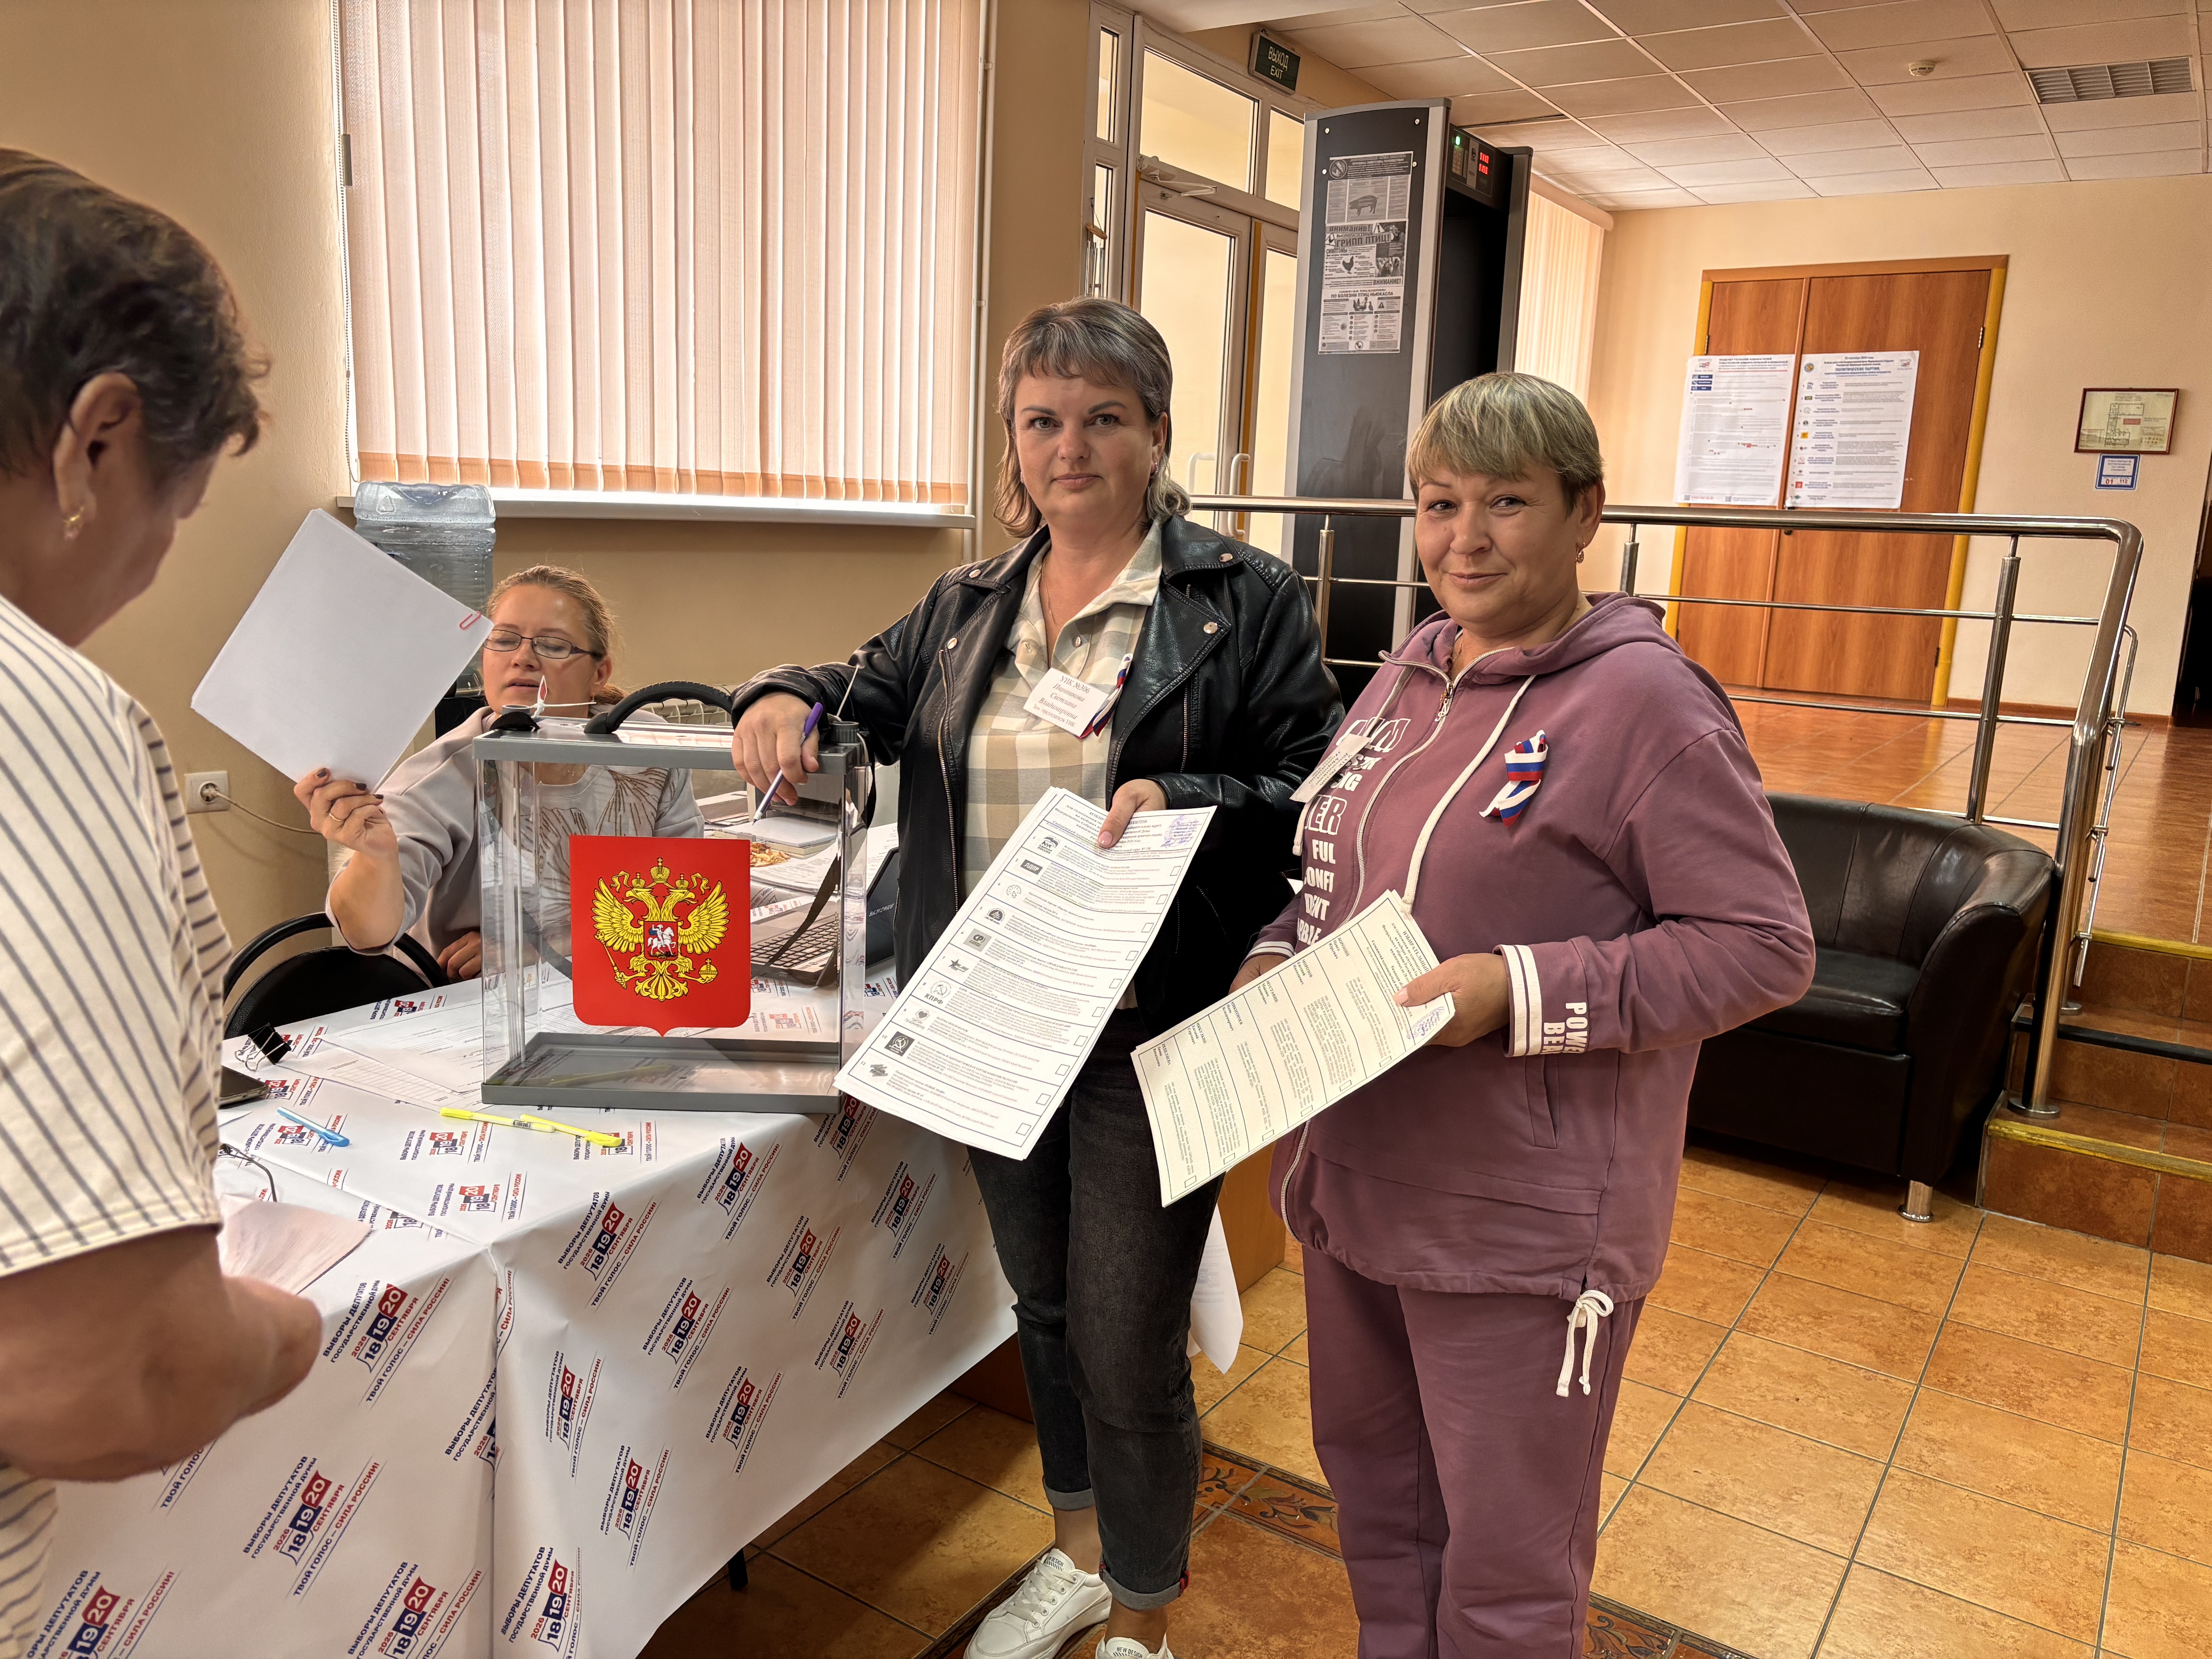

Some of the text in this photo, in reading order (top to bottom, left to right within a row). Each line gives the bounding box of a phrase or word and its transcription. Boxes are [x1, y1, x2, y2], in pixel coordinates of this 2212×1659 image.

[1268, 46, 1289, 71] ВЫХОД
[1271, 65, 1283, 79] EXIT
[1337, 234, 1389, 247] ГРИПП ПТИЦ!
[1039, 697, 1077, 720] Владимировна
[1050, 693, 1077, 708] Светлана
[1060, 676, 1091, 694] УИК №306
[1024, 862, 1039, 872] ЛДПР
[1312, 839, 1336, 864] FUL
[924, 993, 943, 1004] КПРФ
[1539, 1022, 1565, 1054] BEA
[1561, 1002, 1588, 1053] POWE
[871, 1161, 903, 1223] ВЫБОРЫ ДЕПУТАТОВ
[875, 1163, 908, 1228] ГОСУДАРСТВЕННОЙ ДУМЫ
[891, 1181, 911, 1228] 18 19 20
[904, 1186, 920, 1216] СЕНТЯБРЯ
[558, 1192, 599, 1264] ВЫБОРЫ ДЕПУТАТОВ
[564, 1192, 610, 1269] ГОСУДАРСТВЕННОЙ ДУМЫ
[609, 1218, 633, 1255] СЕНТЯБРЯ
[885, 1210, 893, 1225] 2026
[893, 1243, 902, 1259] ТВОЙ
[902, 1222, 912, 1242] ГОЛОС
[914, 1200, 923, 1216] СИЛА
[922, 1173, 936, 1199] РОССИИ!
[580, 1249, 592, 1266] 2026
[591, 1211, 619, 1270] 18 19 20
[591, 1286, 606, 1306] ТВОЙ
[605, 1262, 622, 1286] ГОЛОС
[625, 1235, 638, 1254] СИЛА
[637, 1202, 657, 1234] РОССИИ!
[323, 1283, 367, 1357] ВЫБОРЫ ДЕПУТАТОВ
[331, 1280, 380, 1363] ГОСУДАРСТВЕННОЙ ДУМЫ
[364, 1291, 401, 1360] 18 19 20
[366, 1379, 384, 1401] ТВОЙ
[383, 1348, 403, 1377] ГОЛОС
[407, 1317, 425, 1339] СИЛА
[424, 1278, 450, 1315] РОССИИ!
[387, 1297, 419, 1341] СЕНТЯБРЯ
[351, 1336, 367, 1357] 2026
[243, 1456, 307, 1554] ВЫБОРЫ ДЕПУТАТОВ
[251, 1458, 317, 1558] ГОСУДАРСТВЕННОЙ ДУМЫ
[288, 1480, 325, 1553] 18 19 20
[294, 1571, 313, 1595] ТВОЙ
[311, 1538, 332, 1569] ГОЛОС
[335, 1504, 354, 1528] СИЛА
[352, 1462, 380, 1502] РОССИИ!
[313, 1485, 345, 1532] СЕНТЯБРЯ
[273, 1529, 290, 1551] 2026
